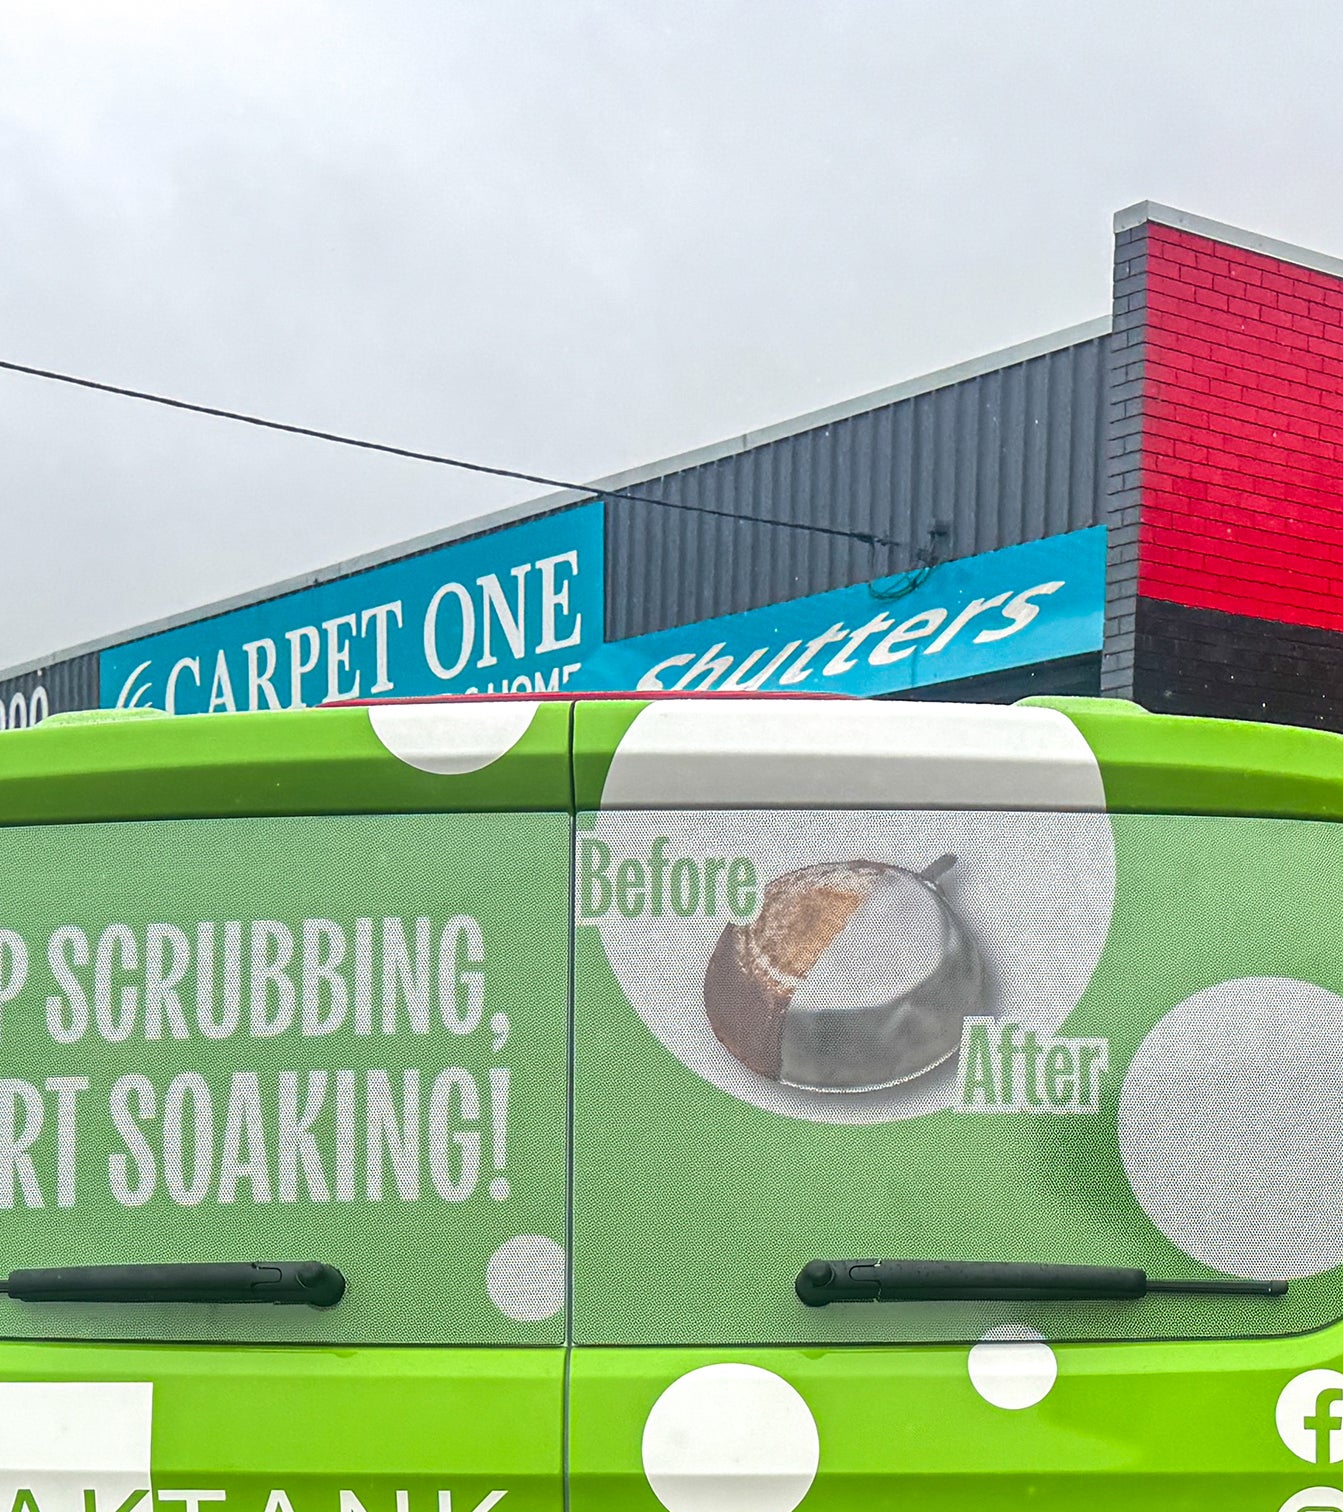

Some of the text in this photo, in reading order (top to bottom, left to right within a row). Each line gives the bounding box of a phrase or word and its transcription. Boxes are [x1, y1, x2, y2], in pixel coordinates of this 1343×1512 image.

[165, 550, 582, 714] CARPET ONE
[580, 836, 758, 919] Before
[46, 914, 511, 1053] SCRUBBING,
[962, 1022, 1100, 1105] After
[107, 1066, 511, 1207] SOAKING!
